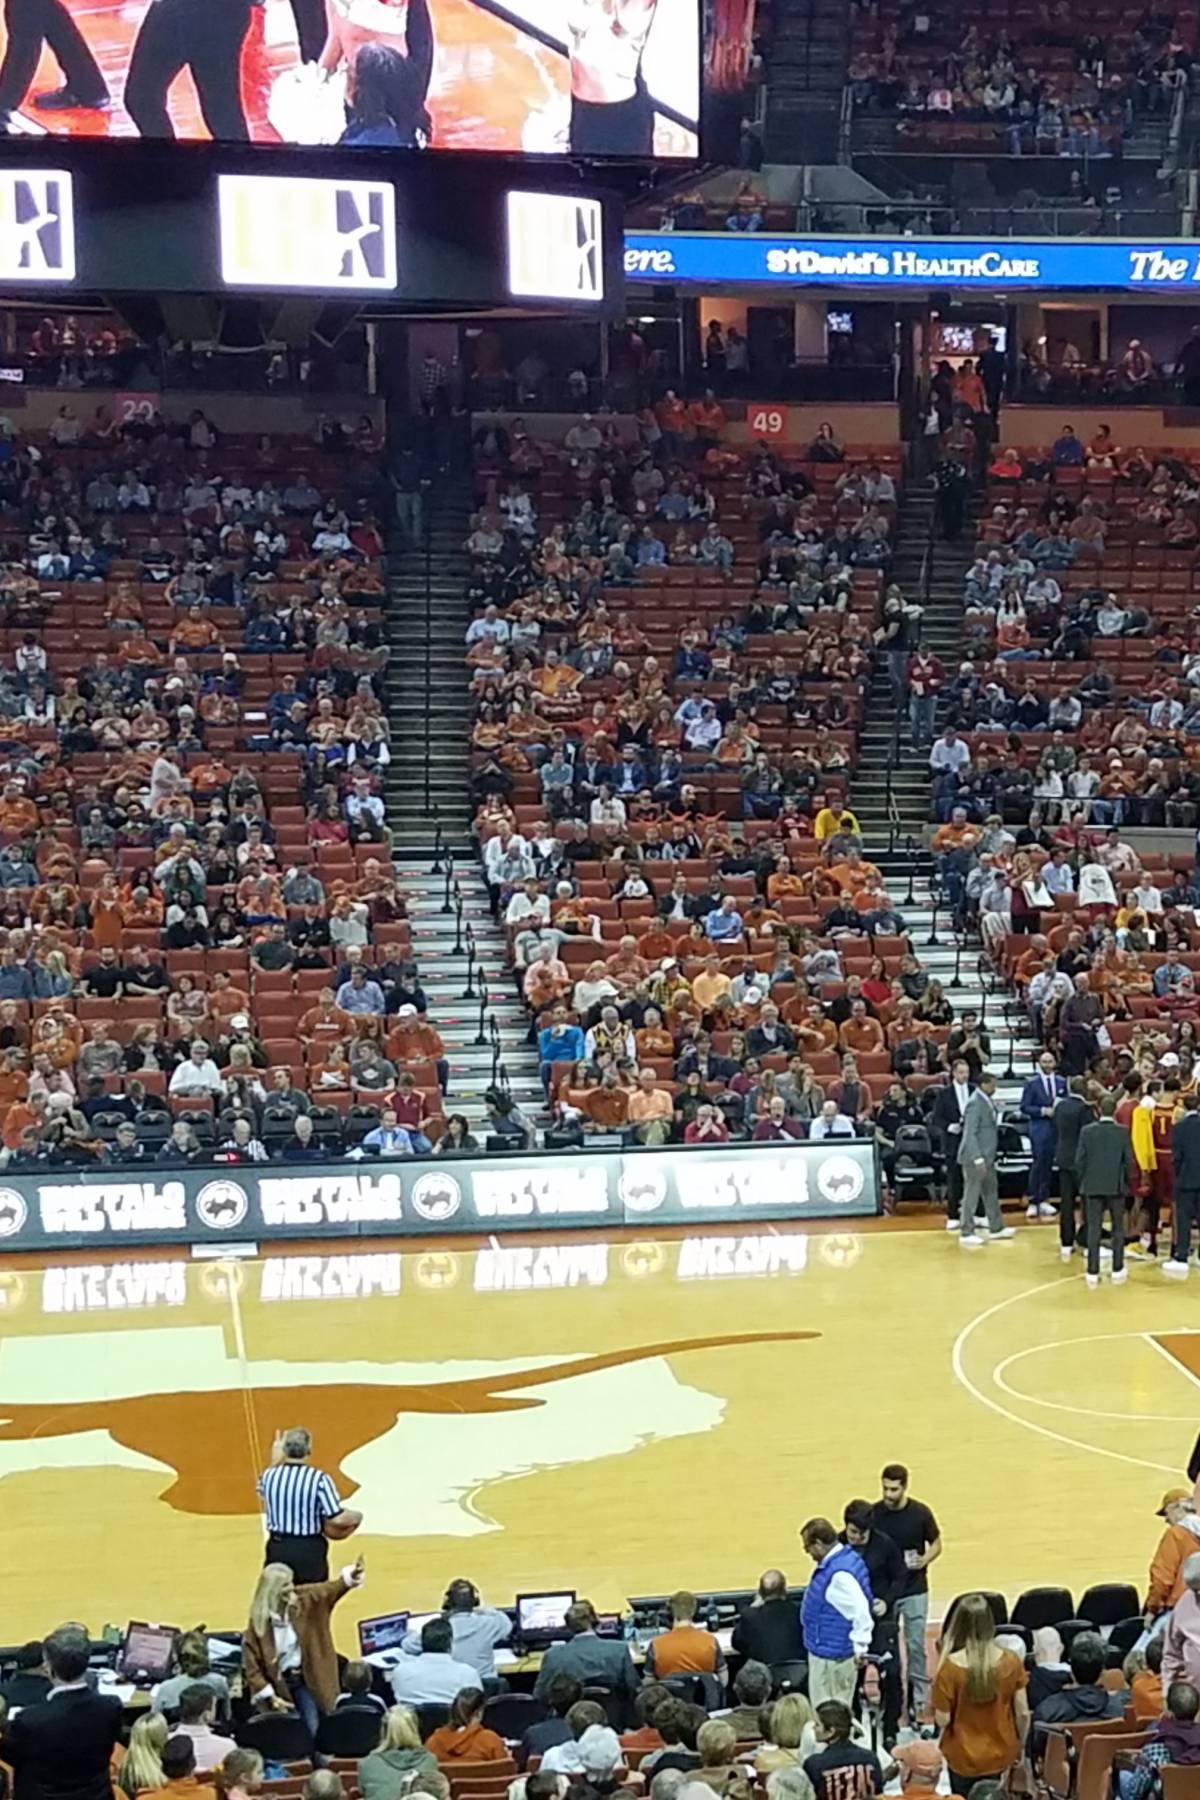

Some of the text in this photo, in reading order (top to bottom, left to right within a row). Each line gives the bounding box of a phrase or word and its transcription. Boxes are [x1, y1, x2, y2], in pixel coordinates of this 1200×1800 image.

[624, 249, 675, 273] ere.
[1130, 251, 1188, 280] The
[753, 411, 783, 433] 49
